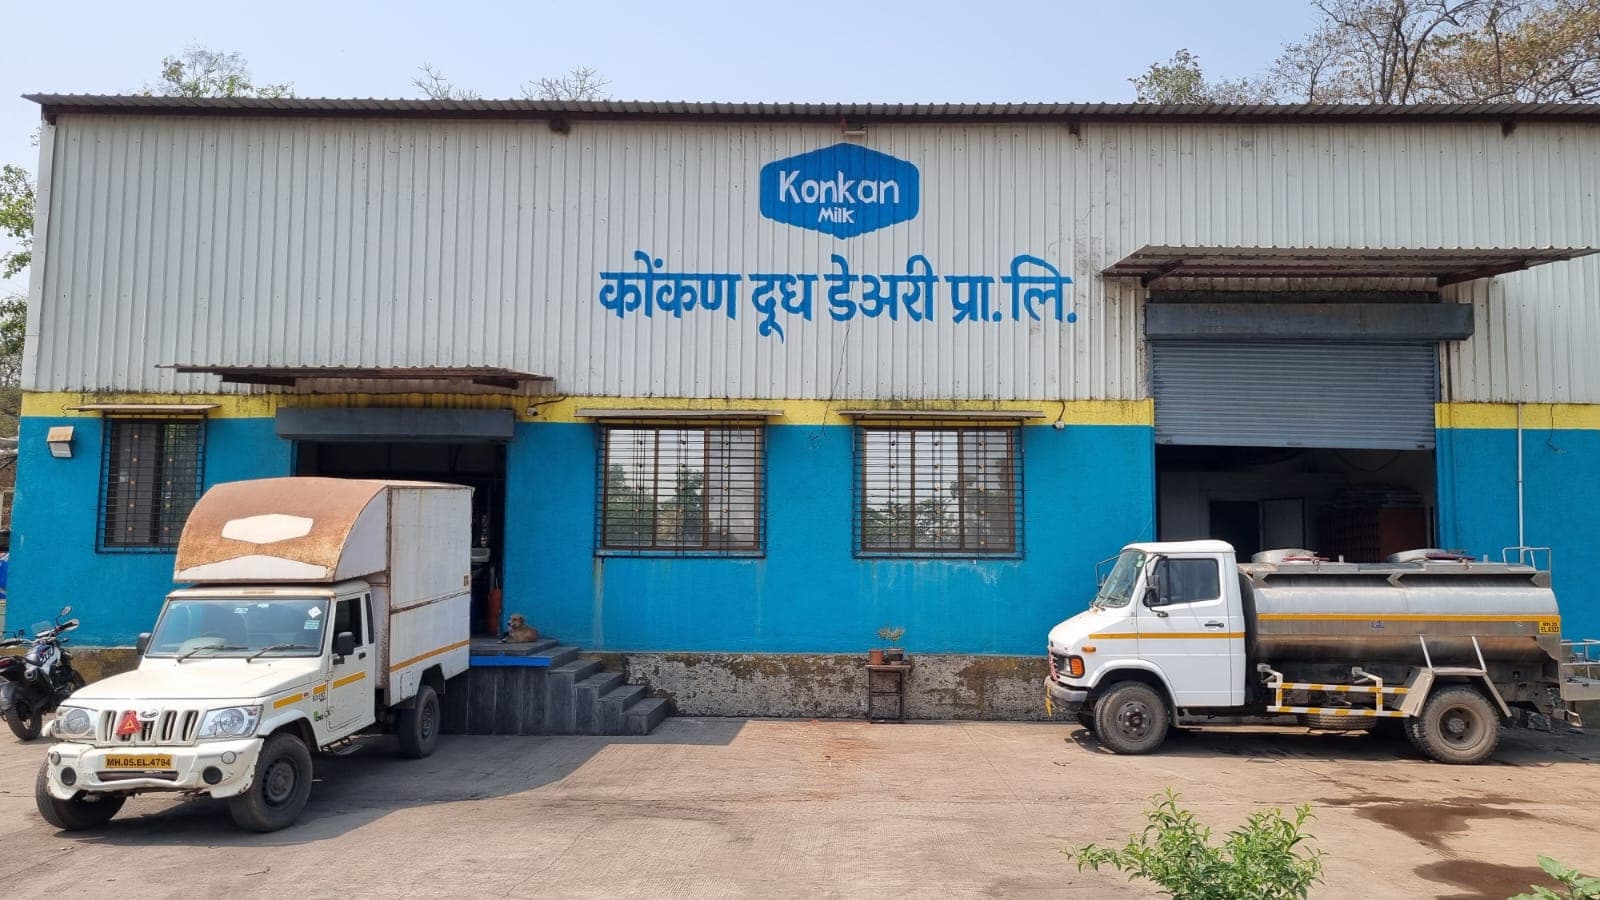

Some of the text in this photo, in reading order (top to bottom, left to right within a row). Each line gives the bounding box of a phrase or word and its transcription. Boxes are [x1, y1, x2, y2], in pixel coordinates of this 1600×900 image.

[778, 170, 901, 205] Konkan
[817, 206, 856, 225] Milk
[599, 251, 742, 320] कोंकण
[748, 273, 819, 343] दूध
[823, 253, 939, 322] डेअरी
